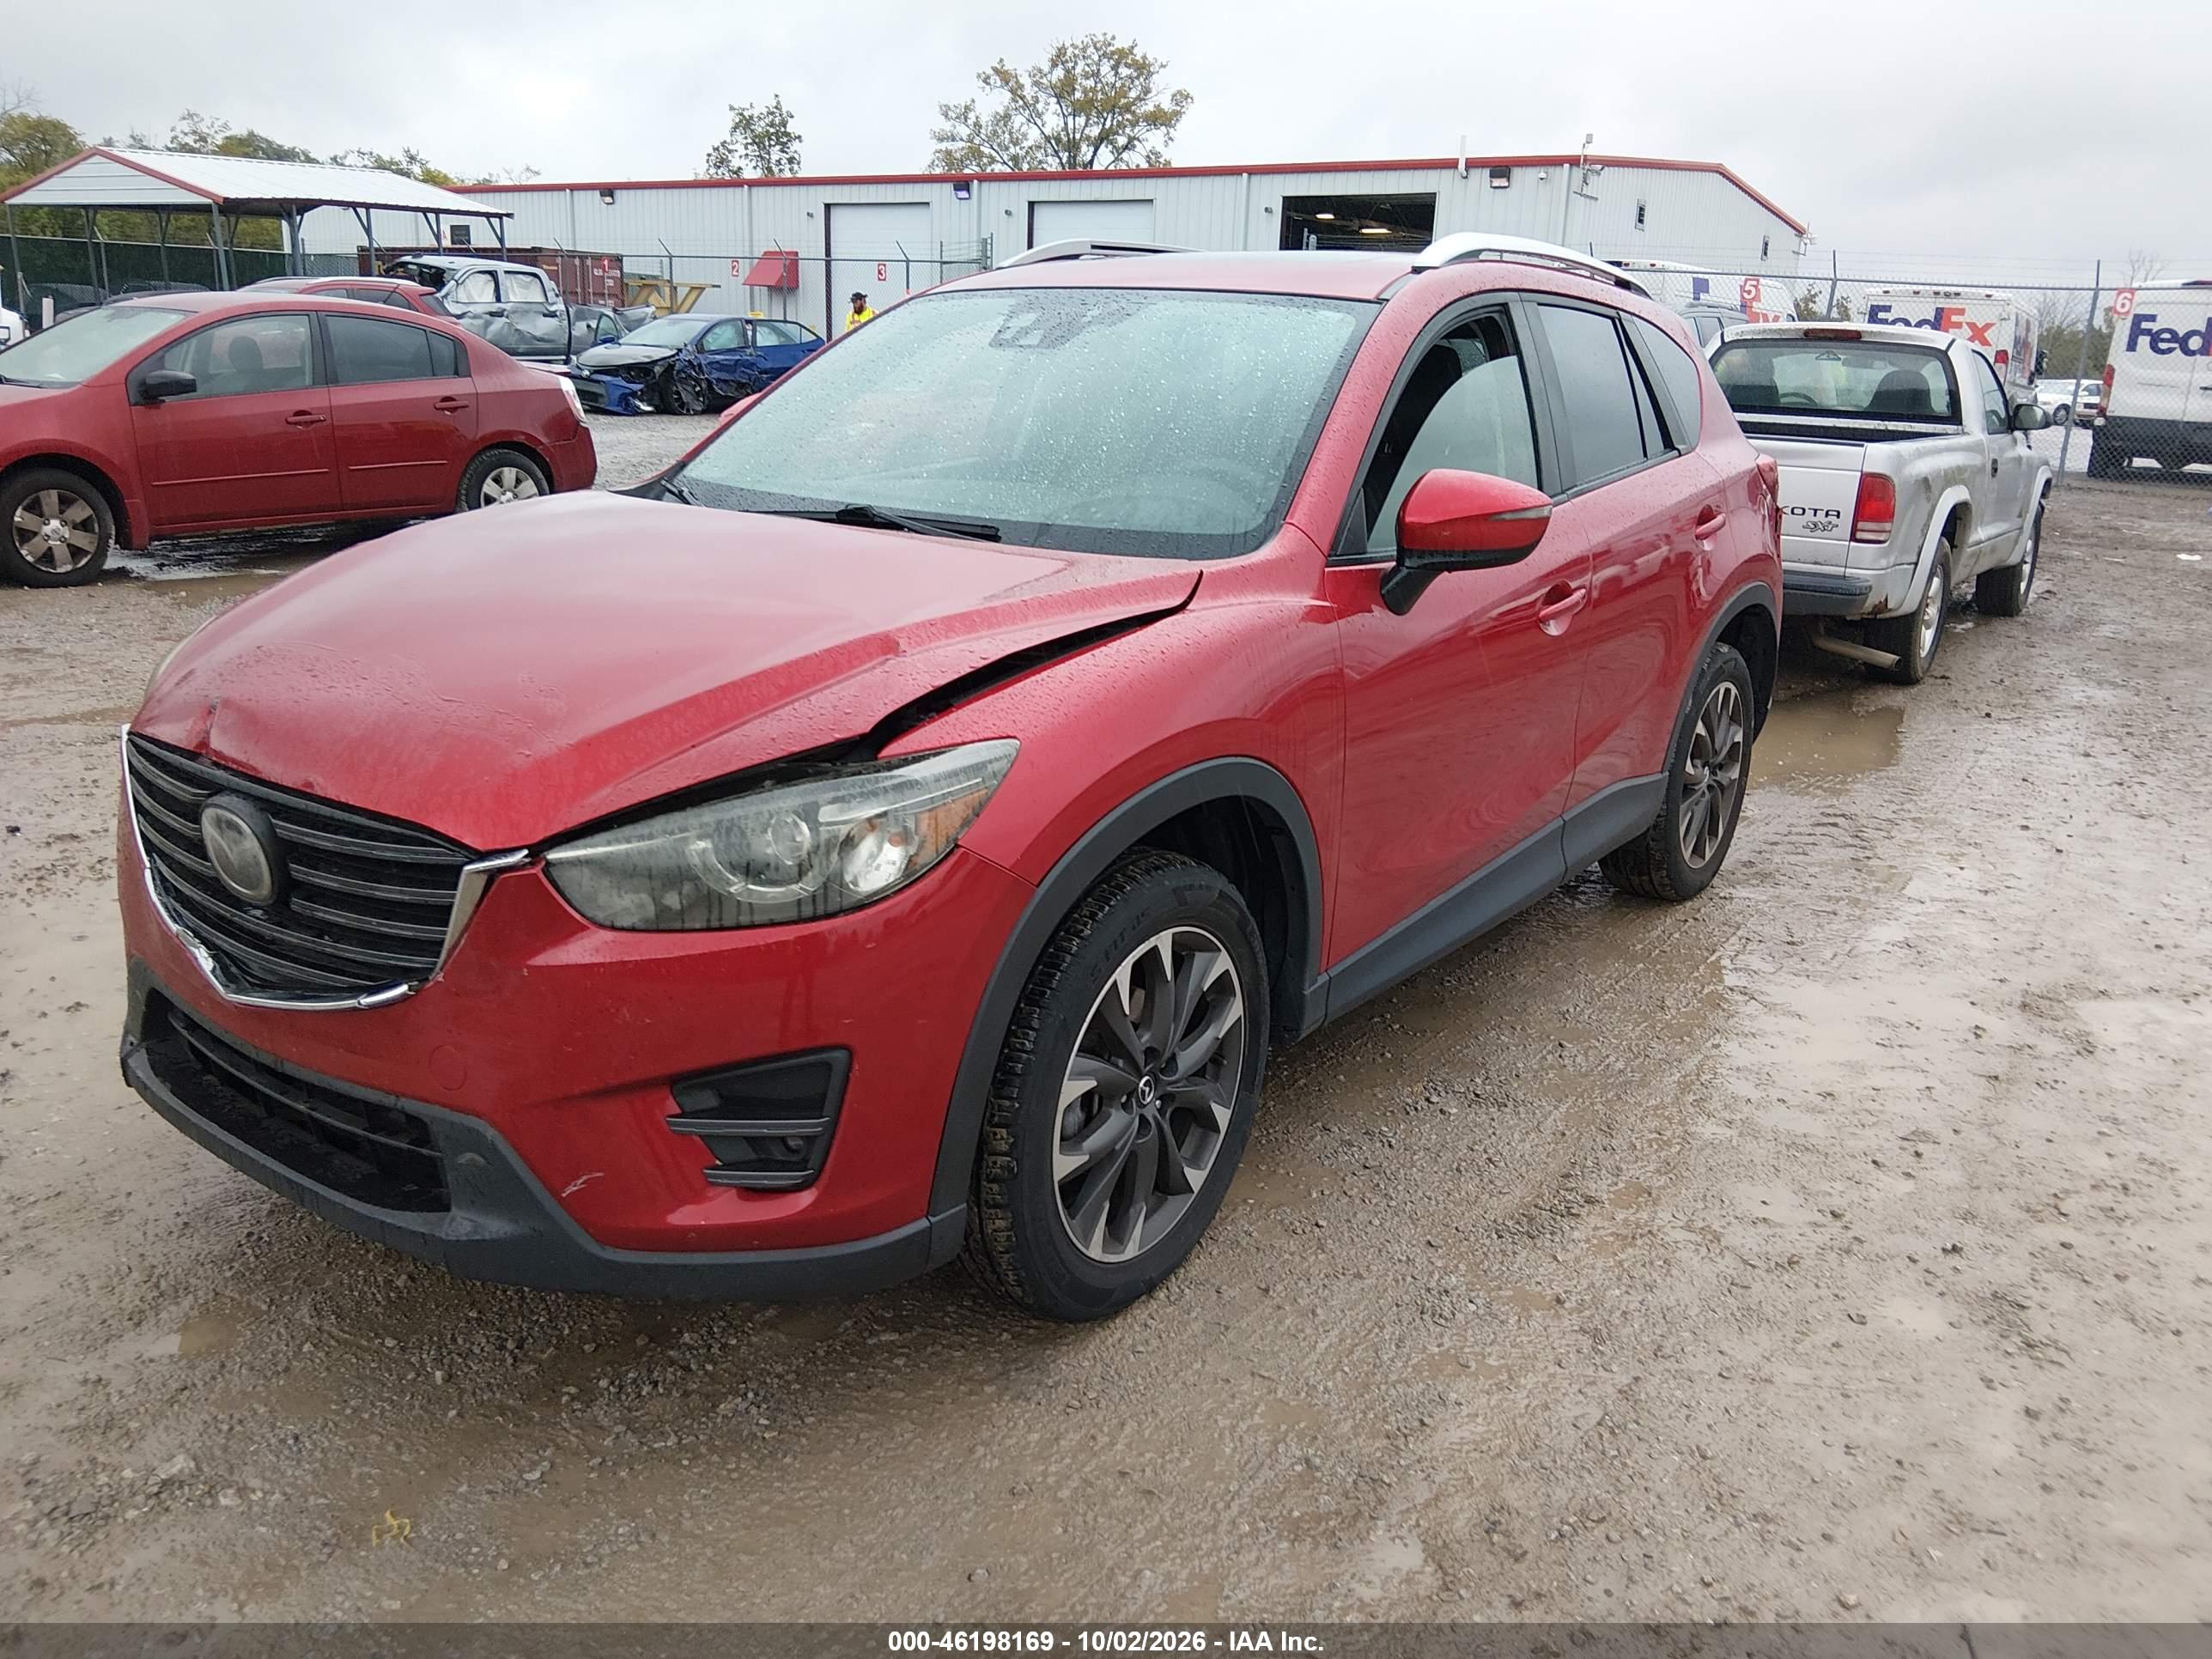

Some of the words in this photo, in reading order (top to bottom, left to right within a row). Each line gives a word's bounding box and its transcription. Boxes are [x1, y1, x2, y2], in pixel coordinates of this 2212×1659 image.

[603, 258, 609, 272] 1
[732, 261, 739, 276] 2
[878, 264, 886, 280] 3
[1742, 280, 1756, 300] 5
[2116, 292, 2133, 313] 6
[2125, 313, 2212, 356] Fed
[1802, 520, 1838, 533] SXT
